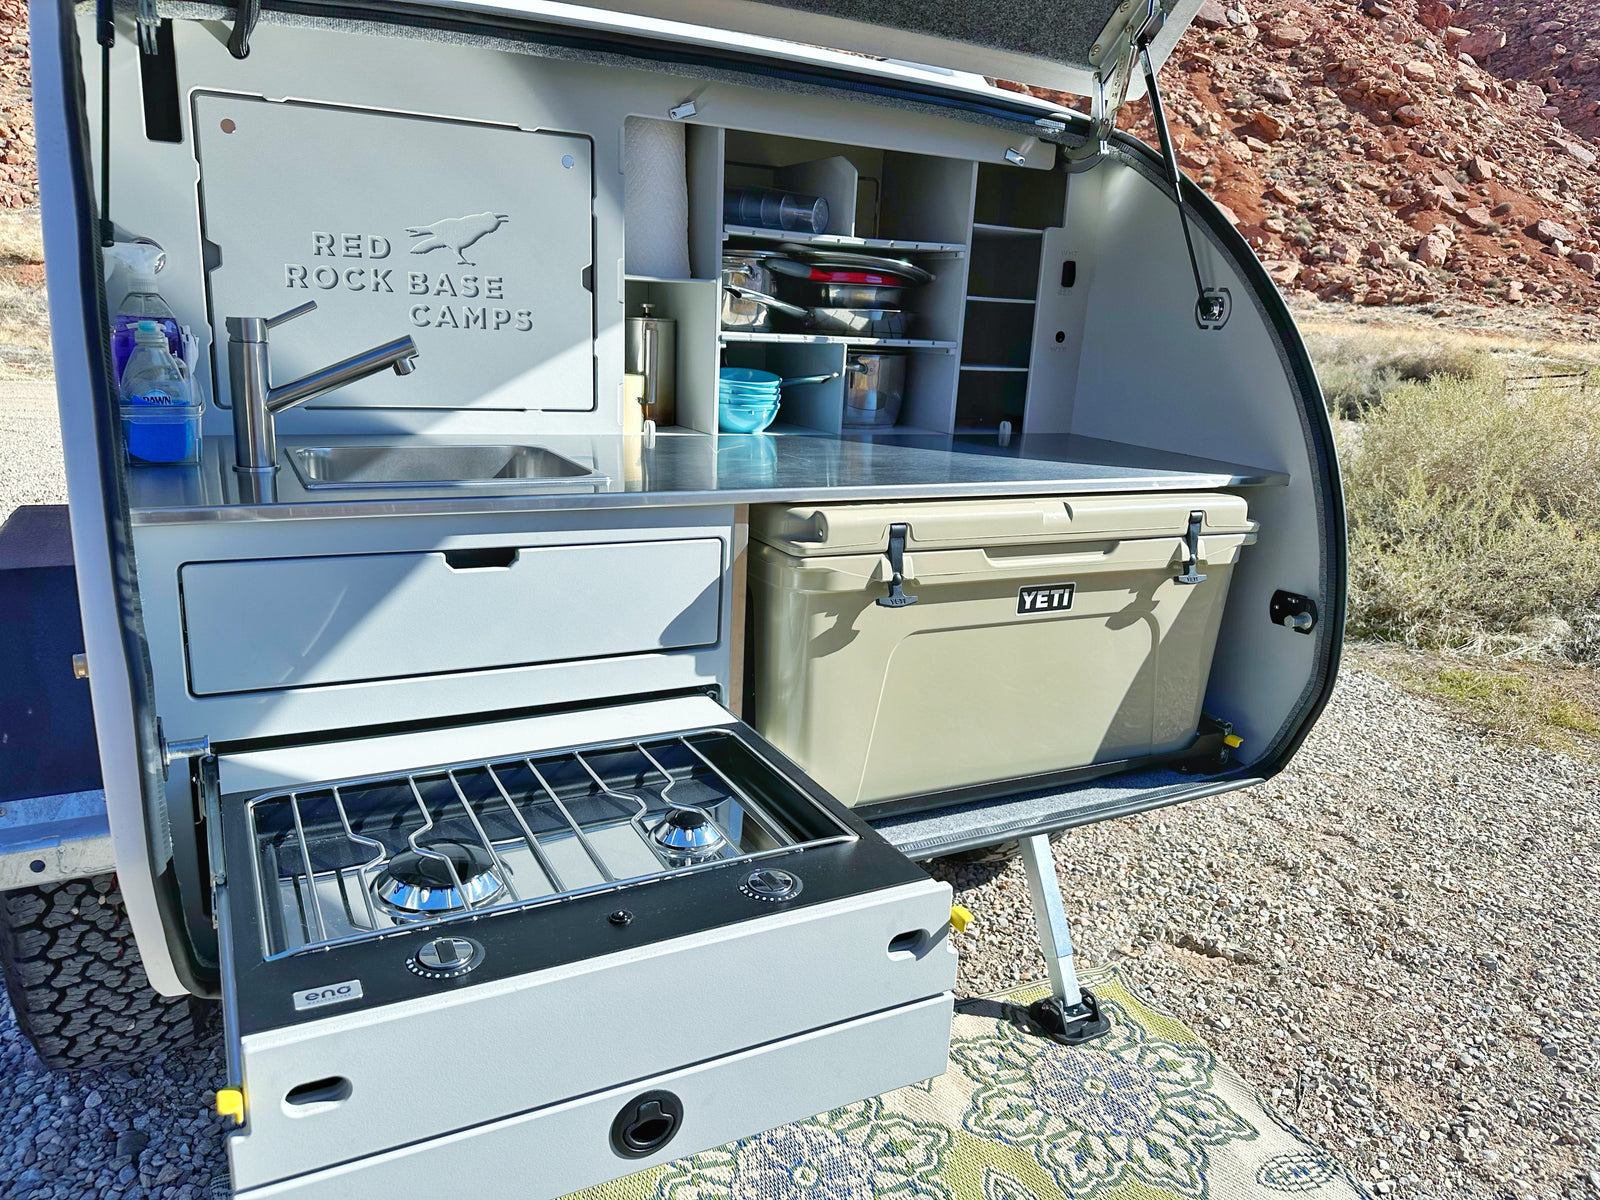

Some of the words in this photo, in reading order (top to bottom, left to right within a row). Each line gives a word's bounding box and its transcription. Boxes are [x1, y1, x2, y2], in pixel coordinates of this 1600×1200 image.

[312, 231, 391, 259] RED
[285, 263, 394, 293] ROCK
[407, 271, 503, 300] BASE
[408, 303, 533, 331] CAMPS
[1022, 588, 1070, 610] YETI
[305, 986, 351, 1001] eno
